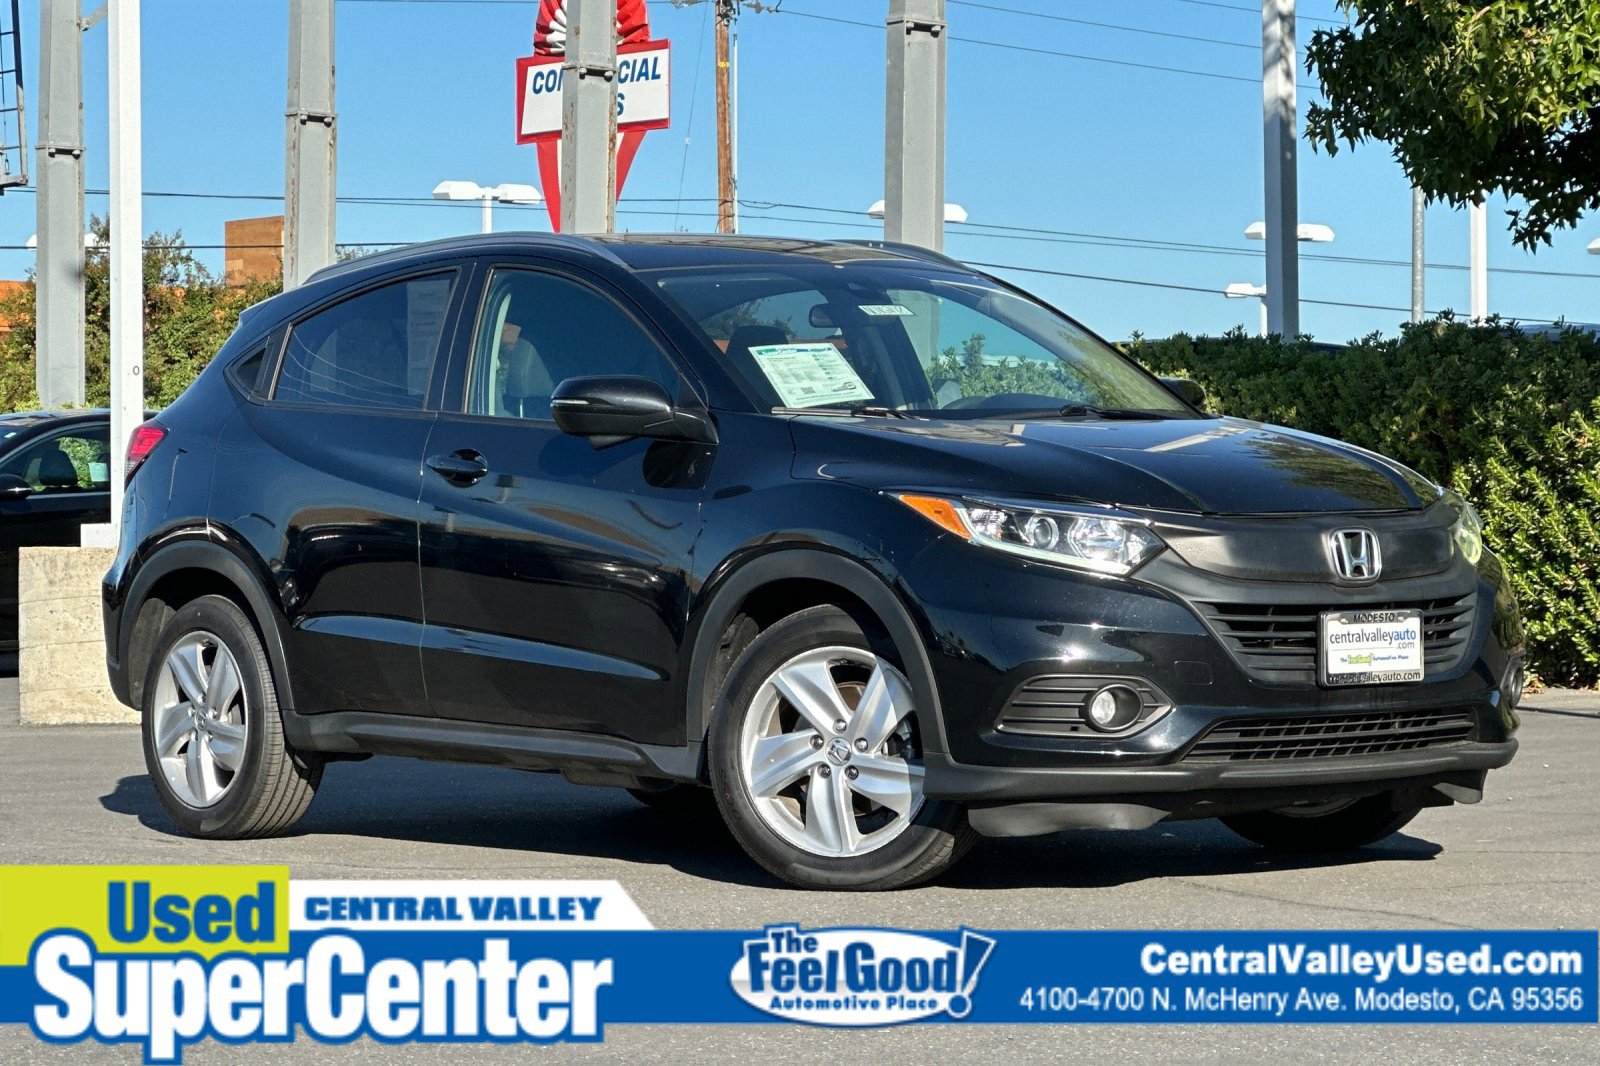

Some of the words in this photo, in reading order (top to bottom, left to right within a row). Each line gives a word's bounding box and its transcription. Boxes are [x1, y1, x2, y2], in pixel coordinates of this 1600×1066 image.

[532, 57, 661, 95] COCIAL
[1353, 612, 1395, 623] MODESTO
[1329, 628, 1417, 645] centralvalleyauto
[1396, 641, 1415, 650] .com
[1329, 672, 1421, 685] lleyauto.com
